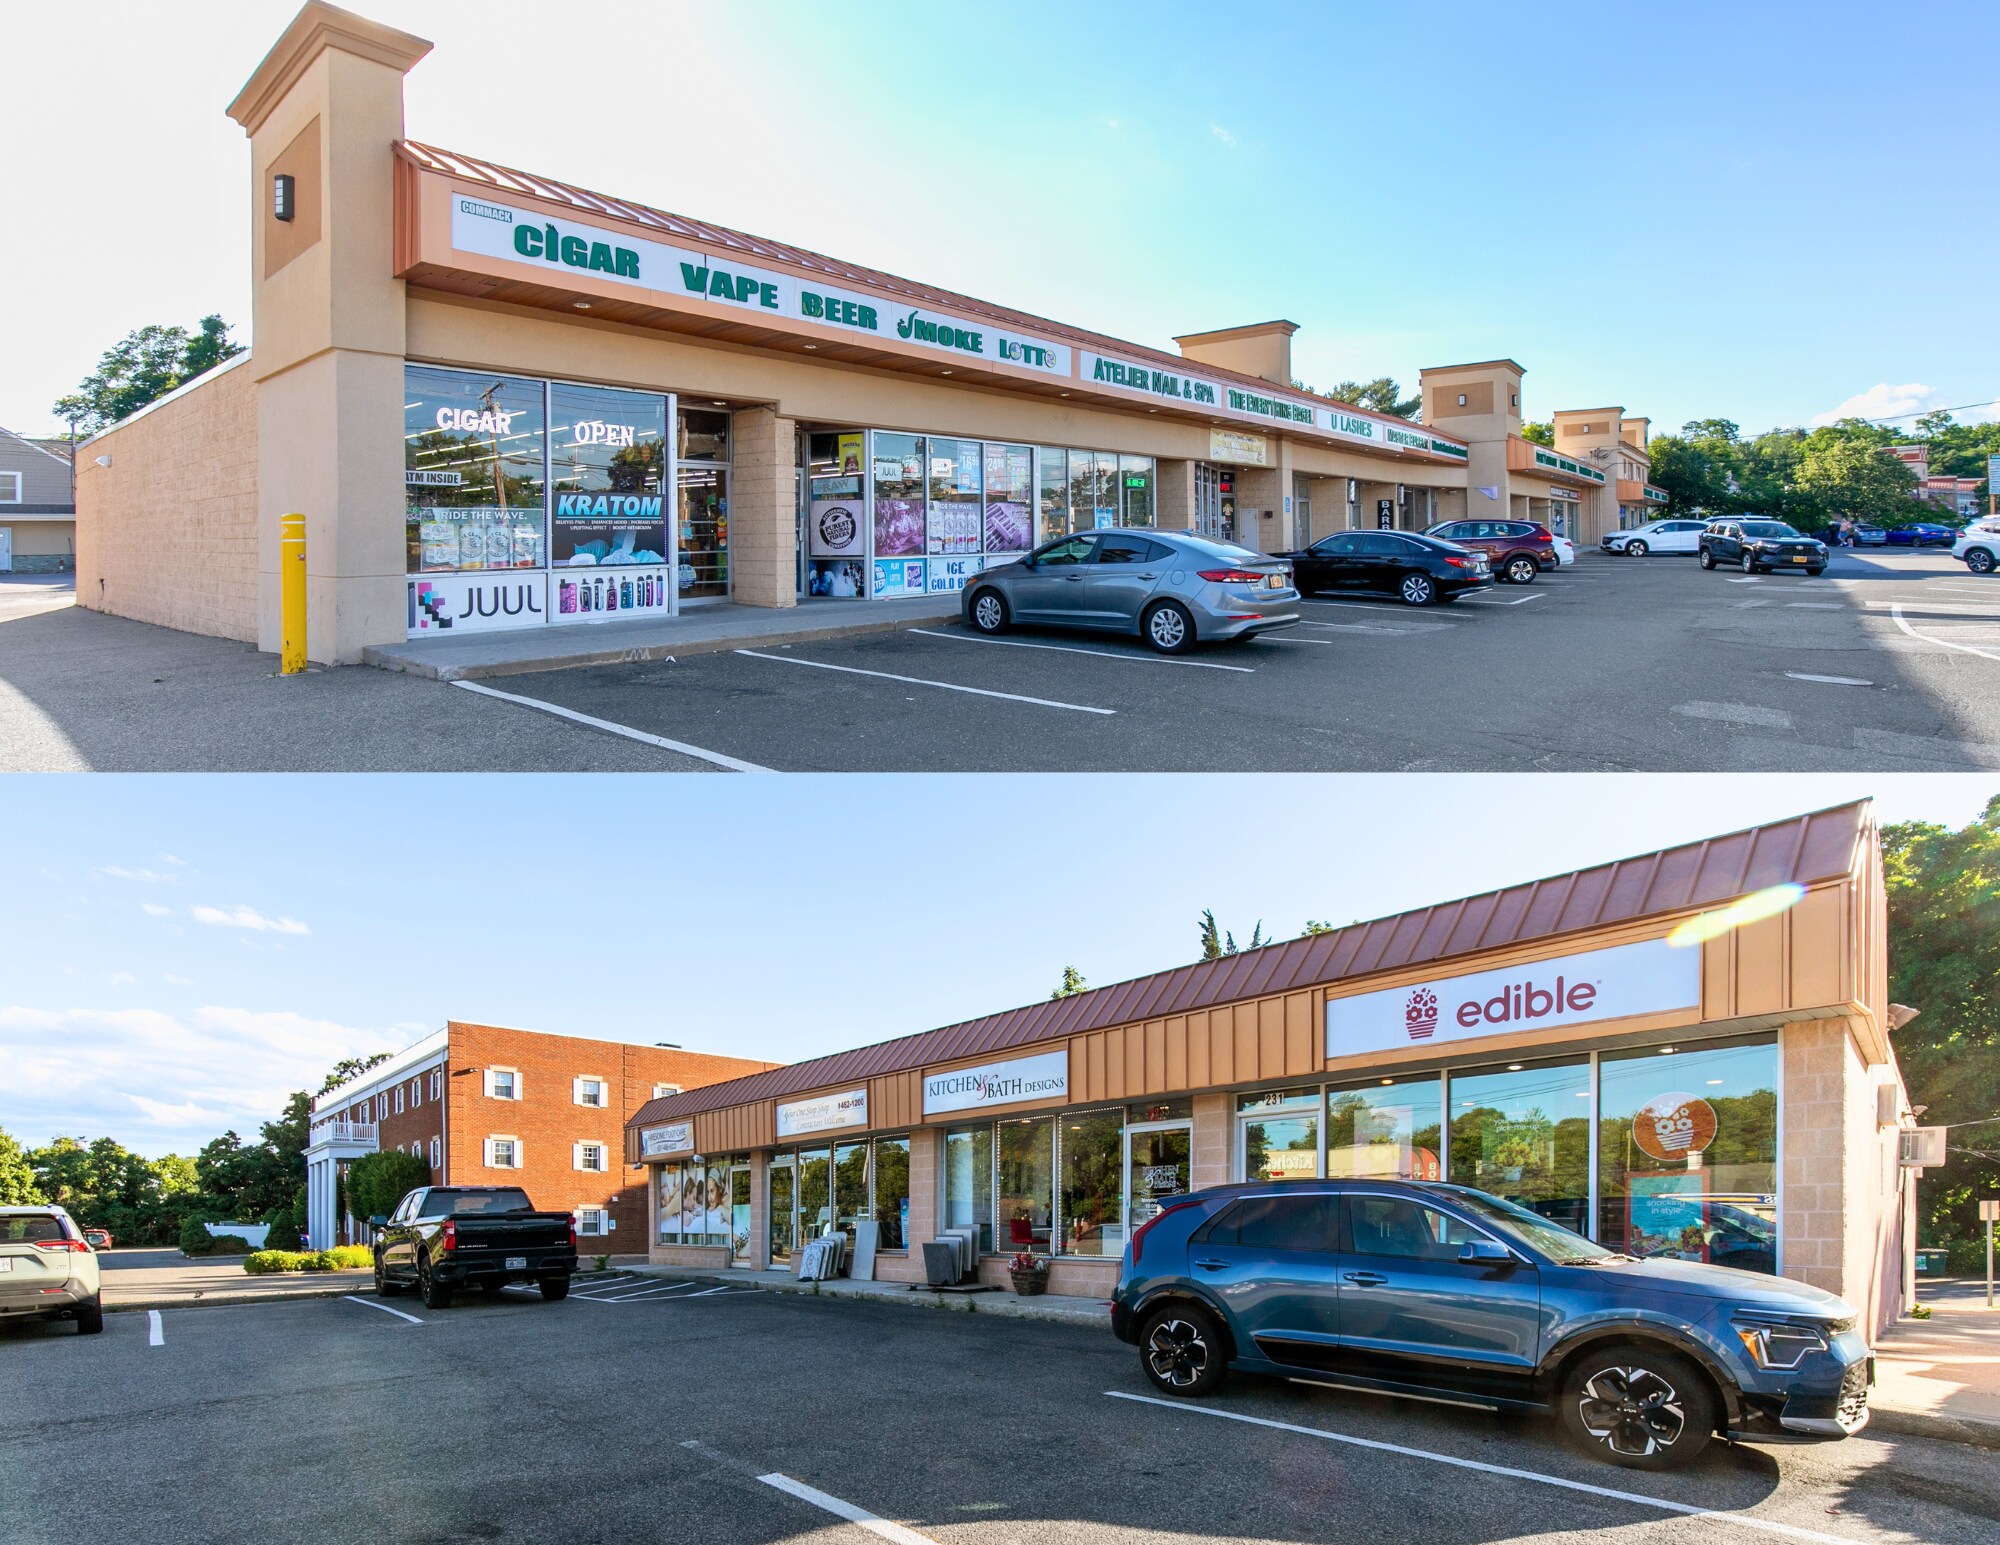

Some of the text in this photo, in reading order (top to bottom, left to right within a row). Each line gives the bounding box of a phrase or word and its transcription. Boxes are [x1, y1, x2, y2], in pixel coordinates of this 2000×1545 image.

[462, 201, 512, 223] COMMACK
[514, 224, 639, 279] CIGAR
[680, 262, 778, 309] VAPE
[802, 291, 878, 330] BEER
[1094, 358, 1215, 404] ATELIER NAIL & SPA
[1228, 389, 1314, 425] THE EVERYTHING BAGEL
[436, 407, 511, 434] CIGAR
[1331, 413, 1373, 438] U LASHES
[574, 421, 634, 447] OPEN
[426, 473, 459, 484] INSIDE
[557, 495, 663, 516] KRATOM
[441, 511, 527, 520] RIDE THE WAVE.
[825, 520, 849, 532] PUREST
[826, 526, 850, 536] NATURAL
[829, 531, 850, 541] FIBERS
[946, 561, 965, 574] ICE
[931, 577, 954, 590] COLD
[460, 585, 542, 619] JUUL
[1456, 976, 1597, 1028] edible
[929, 1074, 1064, 1101] KITCHEN & BATH DESIGNS
[1265, 1094, 1282, 1105] 231
[676, 1127, 687, 1137] CARE
[1496, 1124, 1540, 1133] pick-me-up
[1142, 1164, 1179, 1176] KITCHEN
[1154, 1173, 1176, 1182] BATH
[1647, 1199, 1686, 1208] snacking
[1660, 1207, 1681, 1215] style
